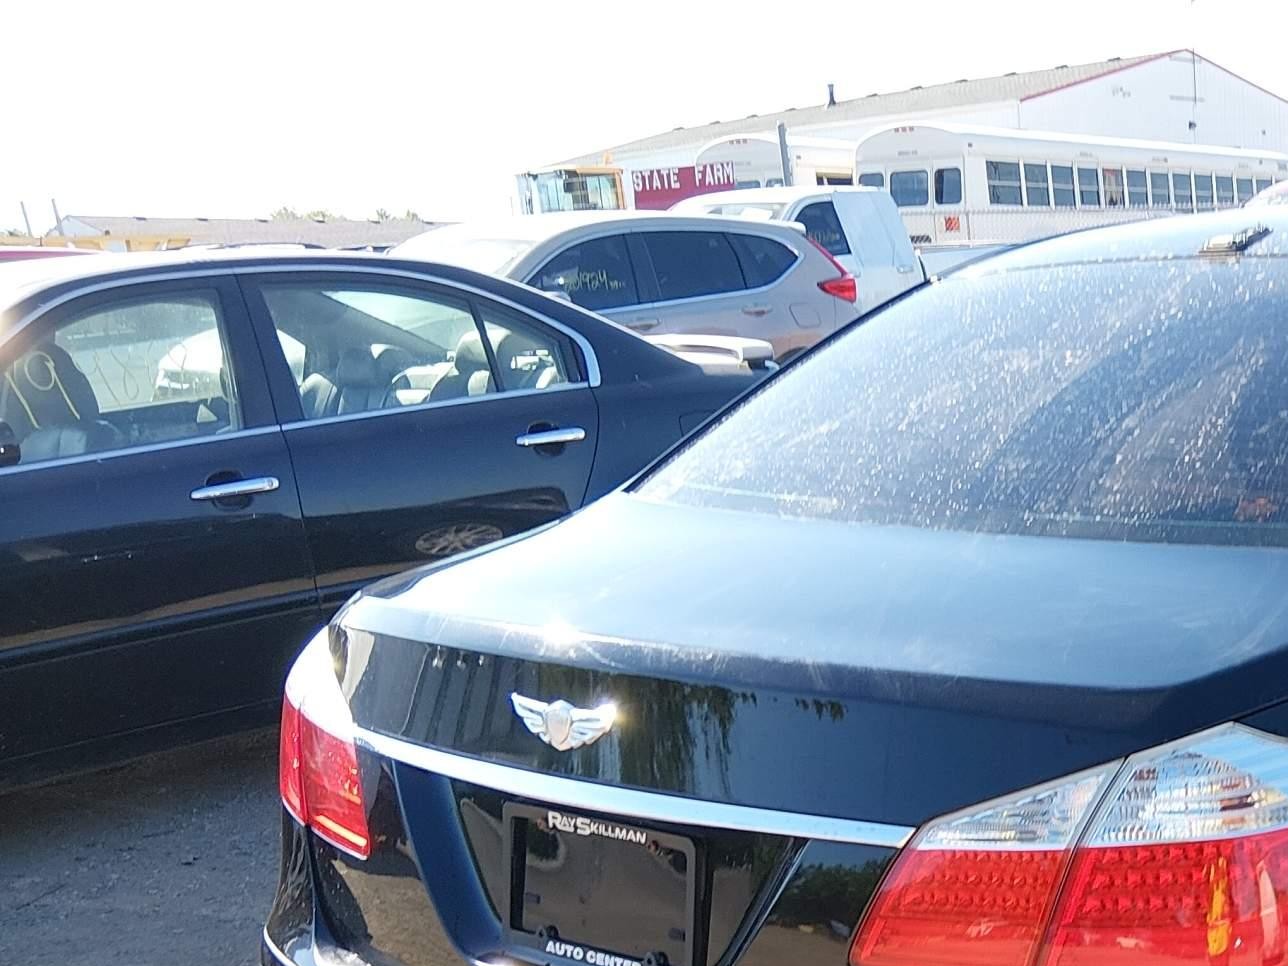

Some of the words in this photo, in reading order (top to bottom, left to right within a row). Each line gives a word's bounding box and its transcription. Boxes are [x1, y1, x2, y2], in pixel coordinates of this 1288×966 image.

[632, 168, 680, 192] STATE
[695, 160, 735, 187] FARM
[545, 940, 584, 960] AUTO
